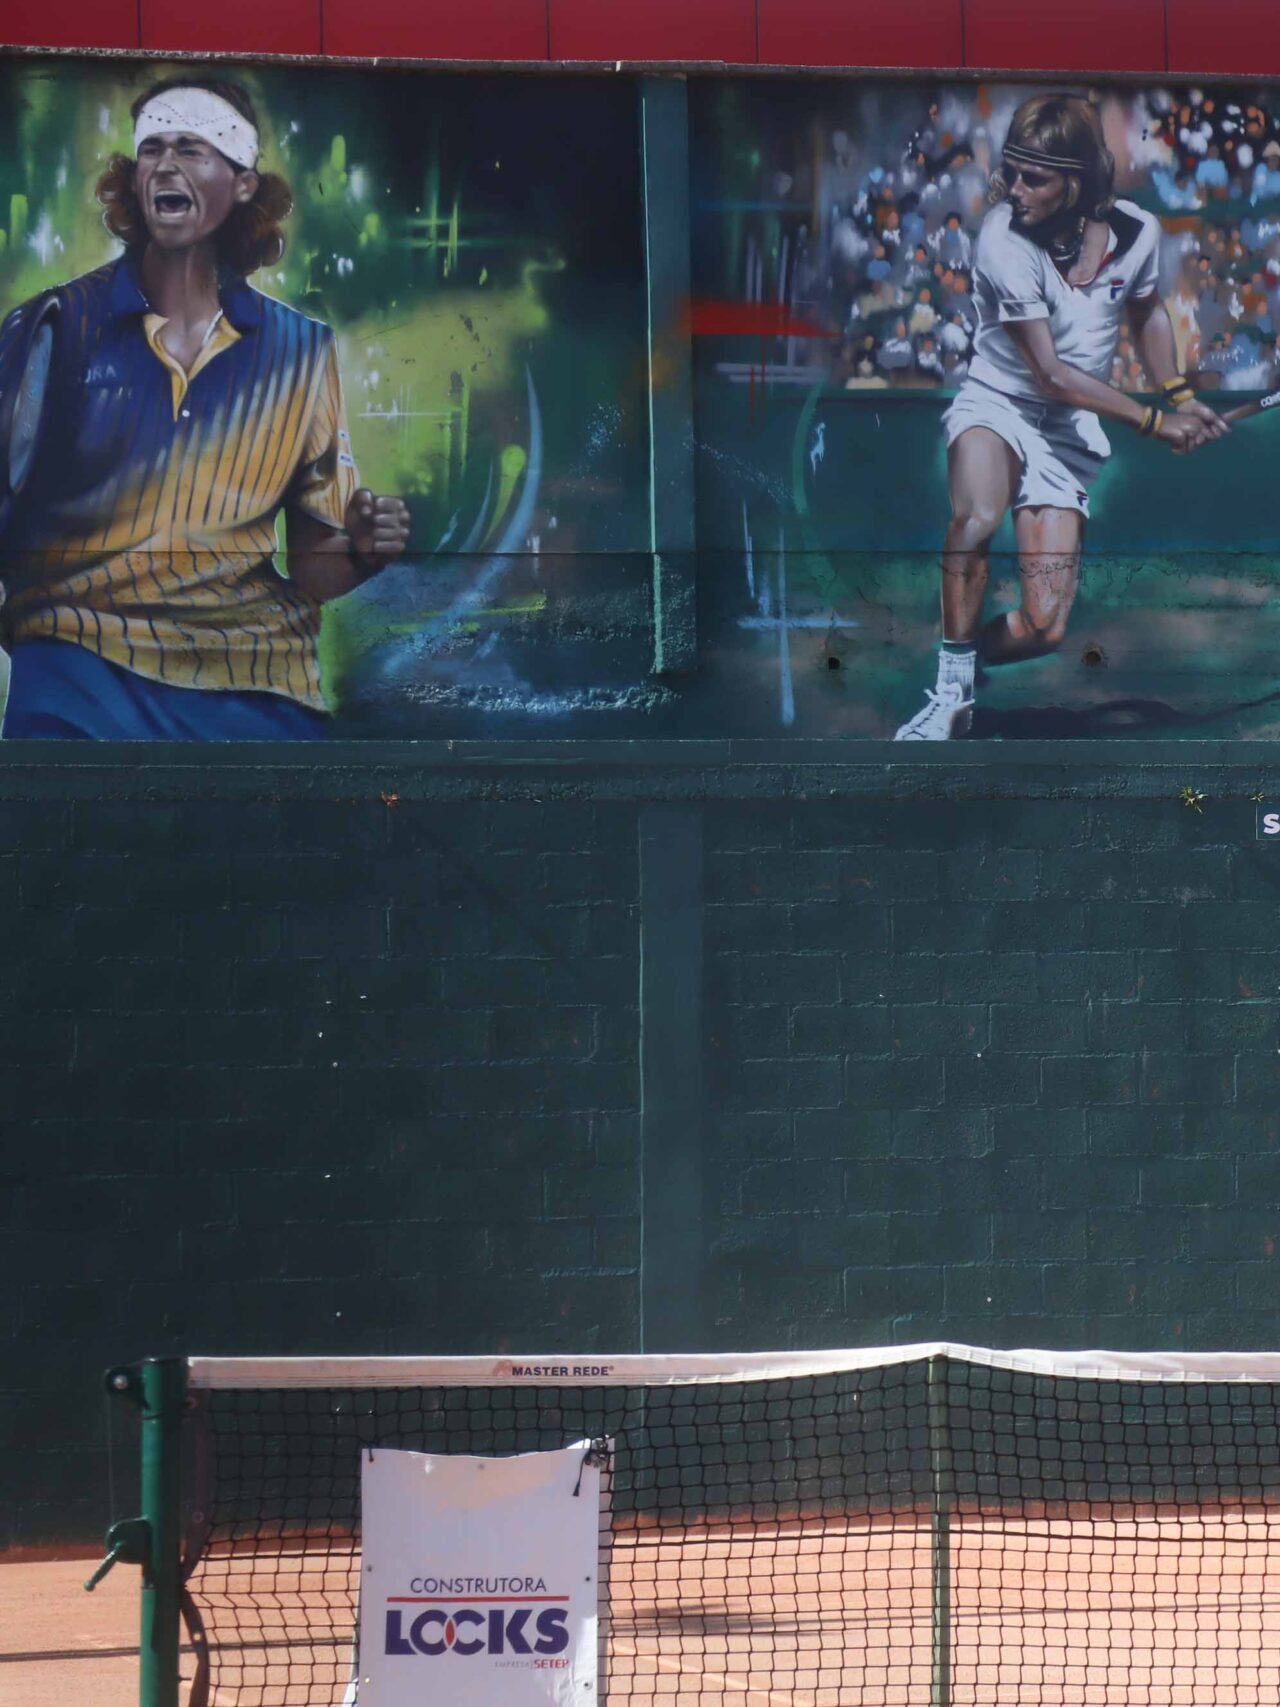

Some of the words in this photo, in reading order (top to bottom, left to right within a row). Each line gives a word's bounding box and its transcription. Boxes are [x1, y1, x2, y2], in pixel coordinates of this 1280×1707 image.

[512, 1366, 568, 1377] MASTER
[410, 1577, 547, 1594] CONSTRUTORA
[385, 1608, 570, 1656] LOCKS
